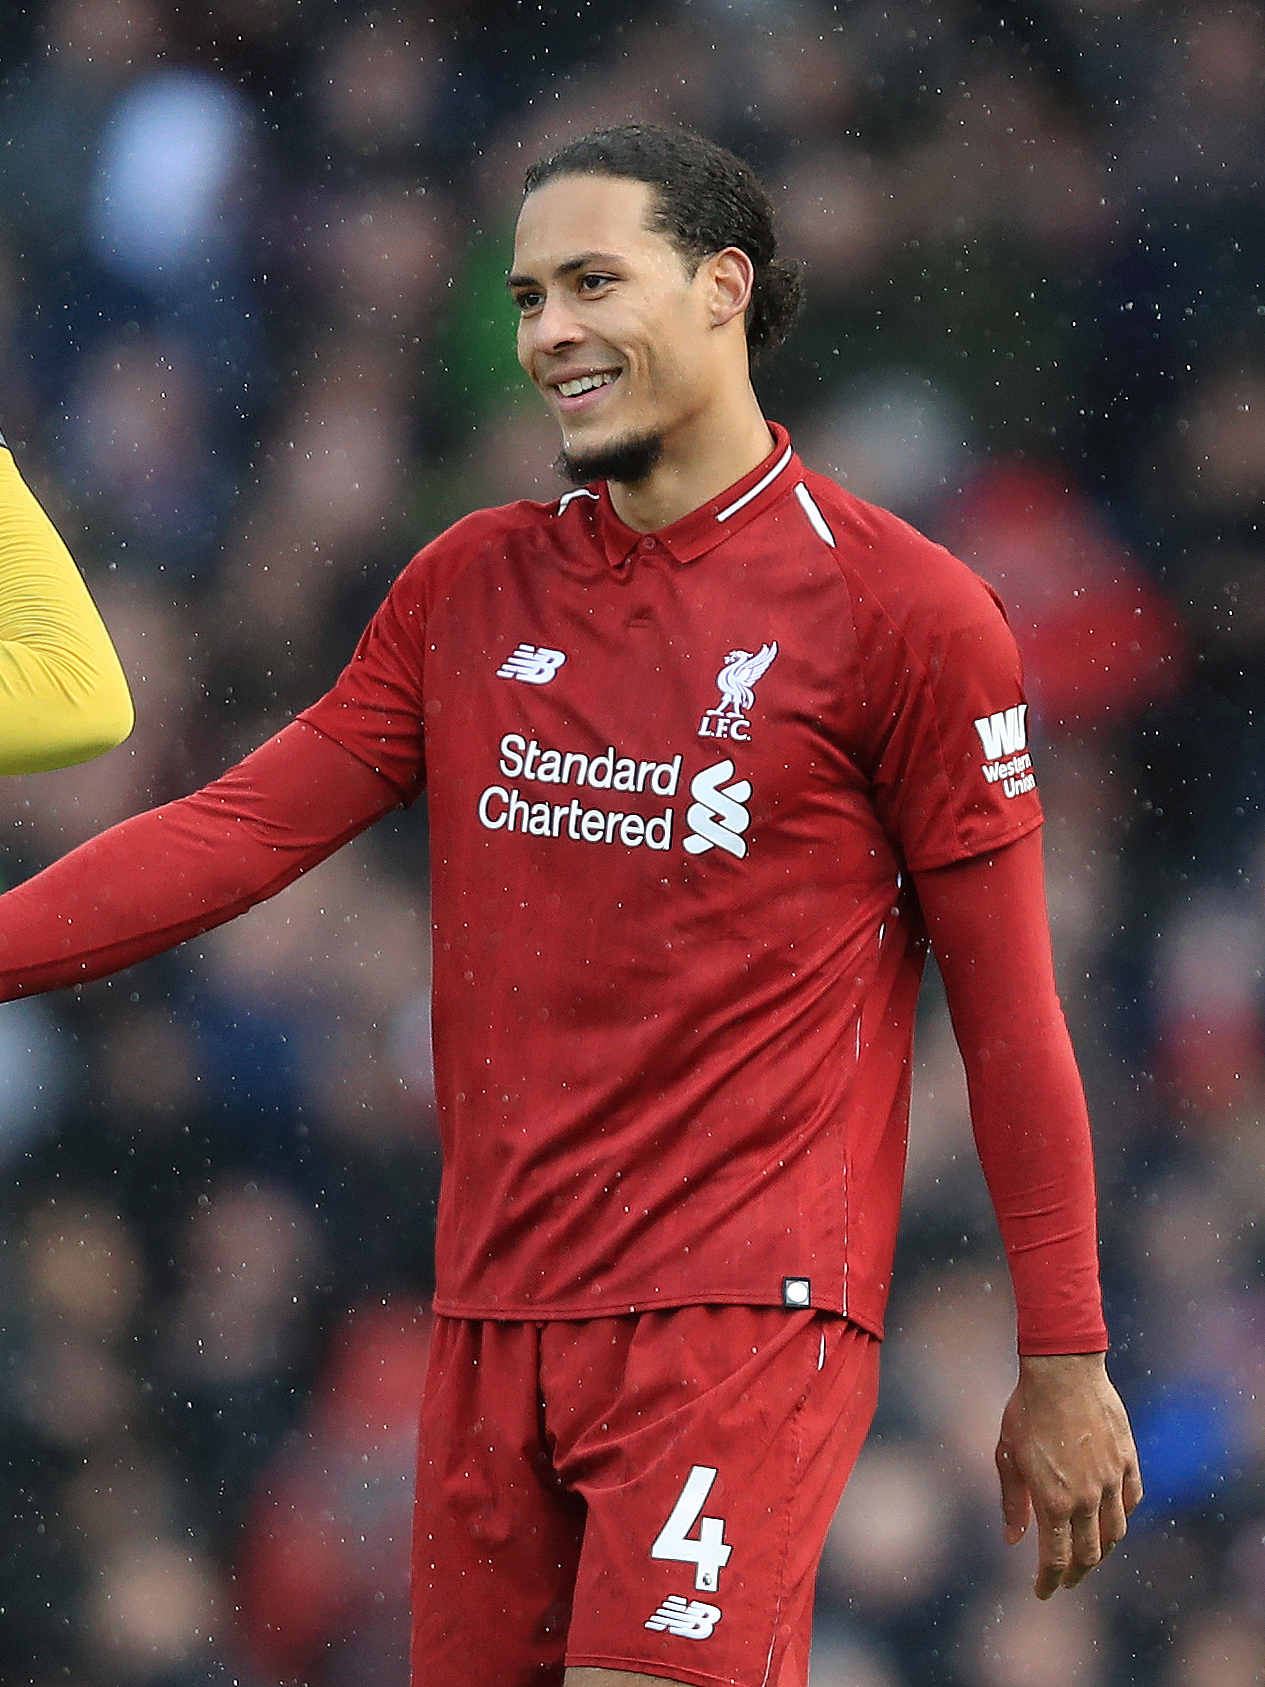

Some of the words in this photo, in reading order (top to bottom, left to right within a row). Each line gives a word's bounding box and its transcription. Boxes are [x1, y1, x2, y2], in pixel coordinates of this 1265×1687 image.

[698, 717, 752, 742] L.F.C.
[499, 733, 682, 796] Standard
[981, 753, 1032, 783] Western
[1003, 773, 1036, 798] Union
[478, 785, 674, 851] Chartered
[651, 1465, 733, 1591] 4
